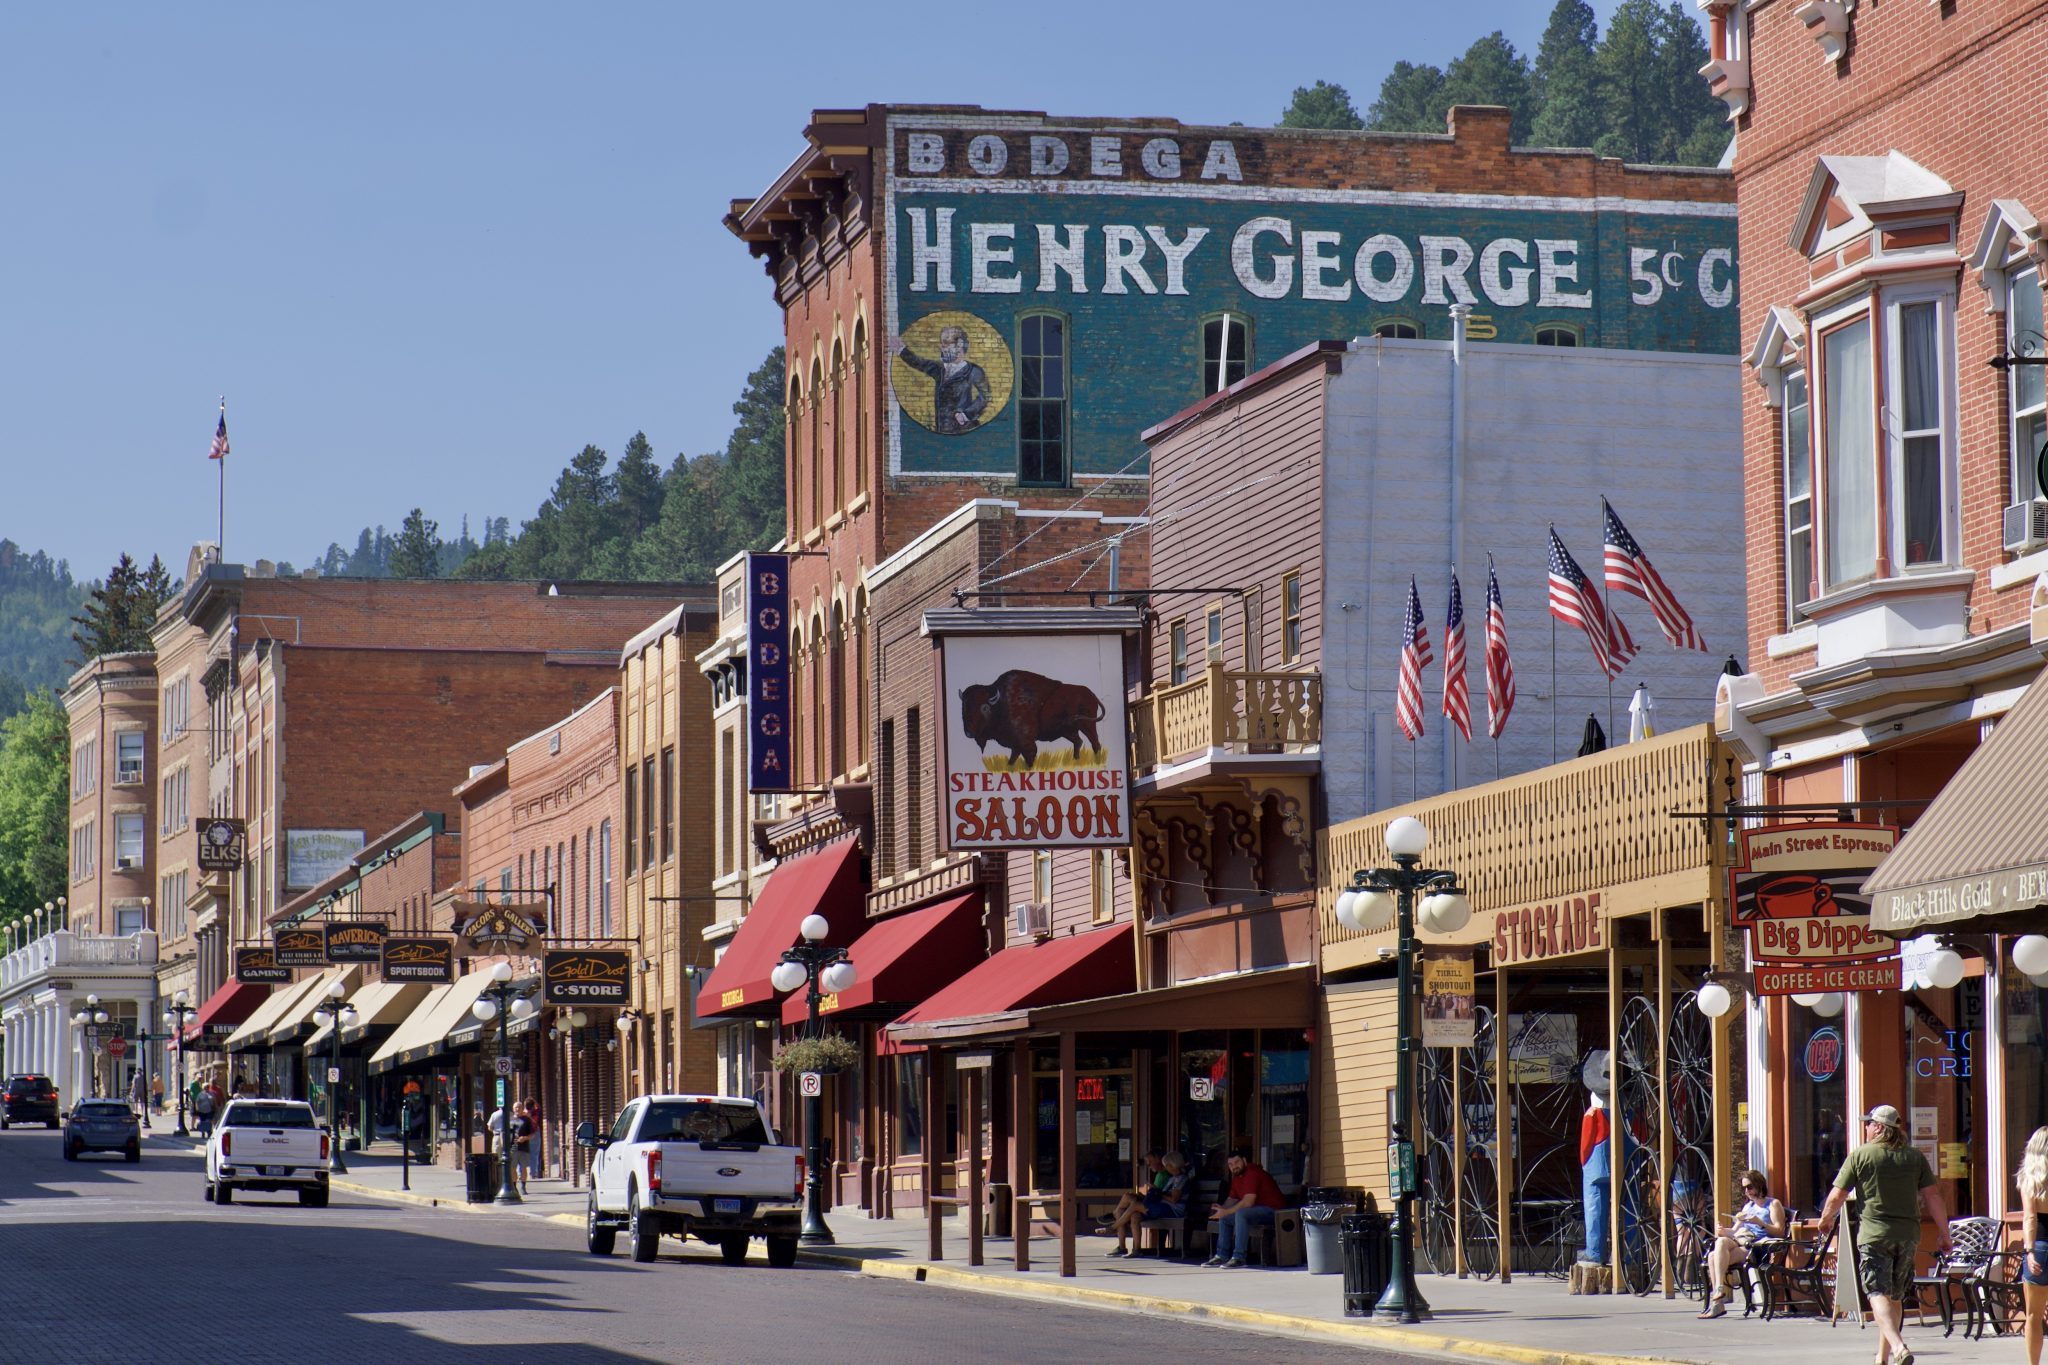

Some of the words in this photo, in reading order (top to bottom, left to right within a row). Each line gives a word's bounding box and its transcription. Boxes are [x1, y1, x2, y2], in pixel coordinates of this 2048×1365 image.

[907, 133, 1243, 181] BODEGA
[905, 207, 1209, 296] HENRY
[1231, 216, 1593, 309] GEORGE
[1698, 247, 1738, 309] C
[759, 572, 782, 772] BODEGA
[950, 769, 1123, 793] STEAKHOUSE
[955, 794, 1123, 843] SALOON
[201, 846, 240, 860] ELKS
[1752, 842, 1782, 860] Main
[1785, 835, 1828, 853] Street
[1833, 835, 1892, 853] Espresso
[1891, 892, 1926, 921] Black
[1927, 887, 1957, 917] Hills
[1961, 880, 1992, 911] Gold
[466, 908, 496, 937] JACOBS
[504, 909, 535, 937] GALLERY
[1495, 893, 1601, 962] STOCKADE
[1762, 920, 1801, 955] Big
[385, 945, 419, 960] Gold
[415, 945, 449, 960] Dust
[390, 967, 445, 976] SPORTSBOOK
[547, 957, 588, 978] Gold
[581, 958, 627, 978] Dust
[1436, 969, 1462, 977] THRILL
[1762, 972, 1813, 990] COFFEE
[1824, 971, 1844, 987] ICE
[1850, 969, 1895, 985] CREAM
[1429, 981, 1471, 990] SHOOTOUT!
[722, 988, 744, 1008] BODEGA
[819, 992, 839, 1012] DEGA
[1808, 1039, 1837, 1072] OPEN
[1077, 1078, 1104, 1100] ATM
